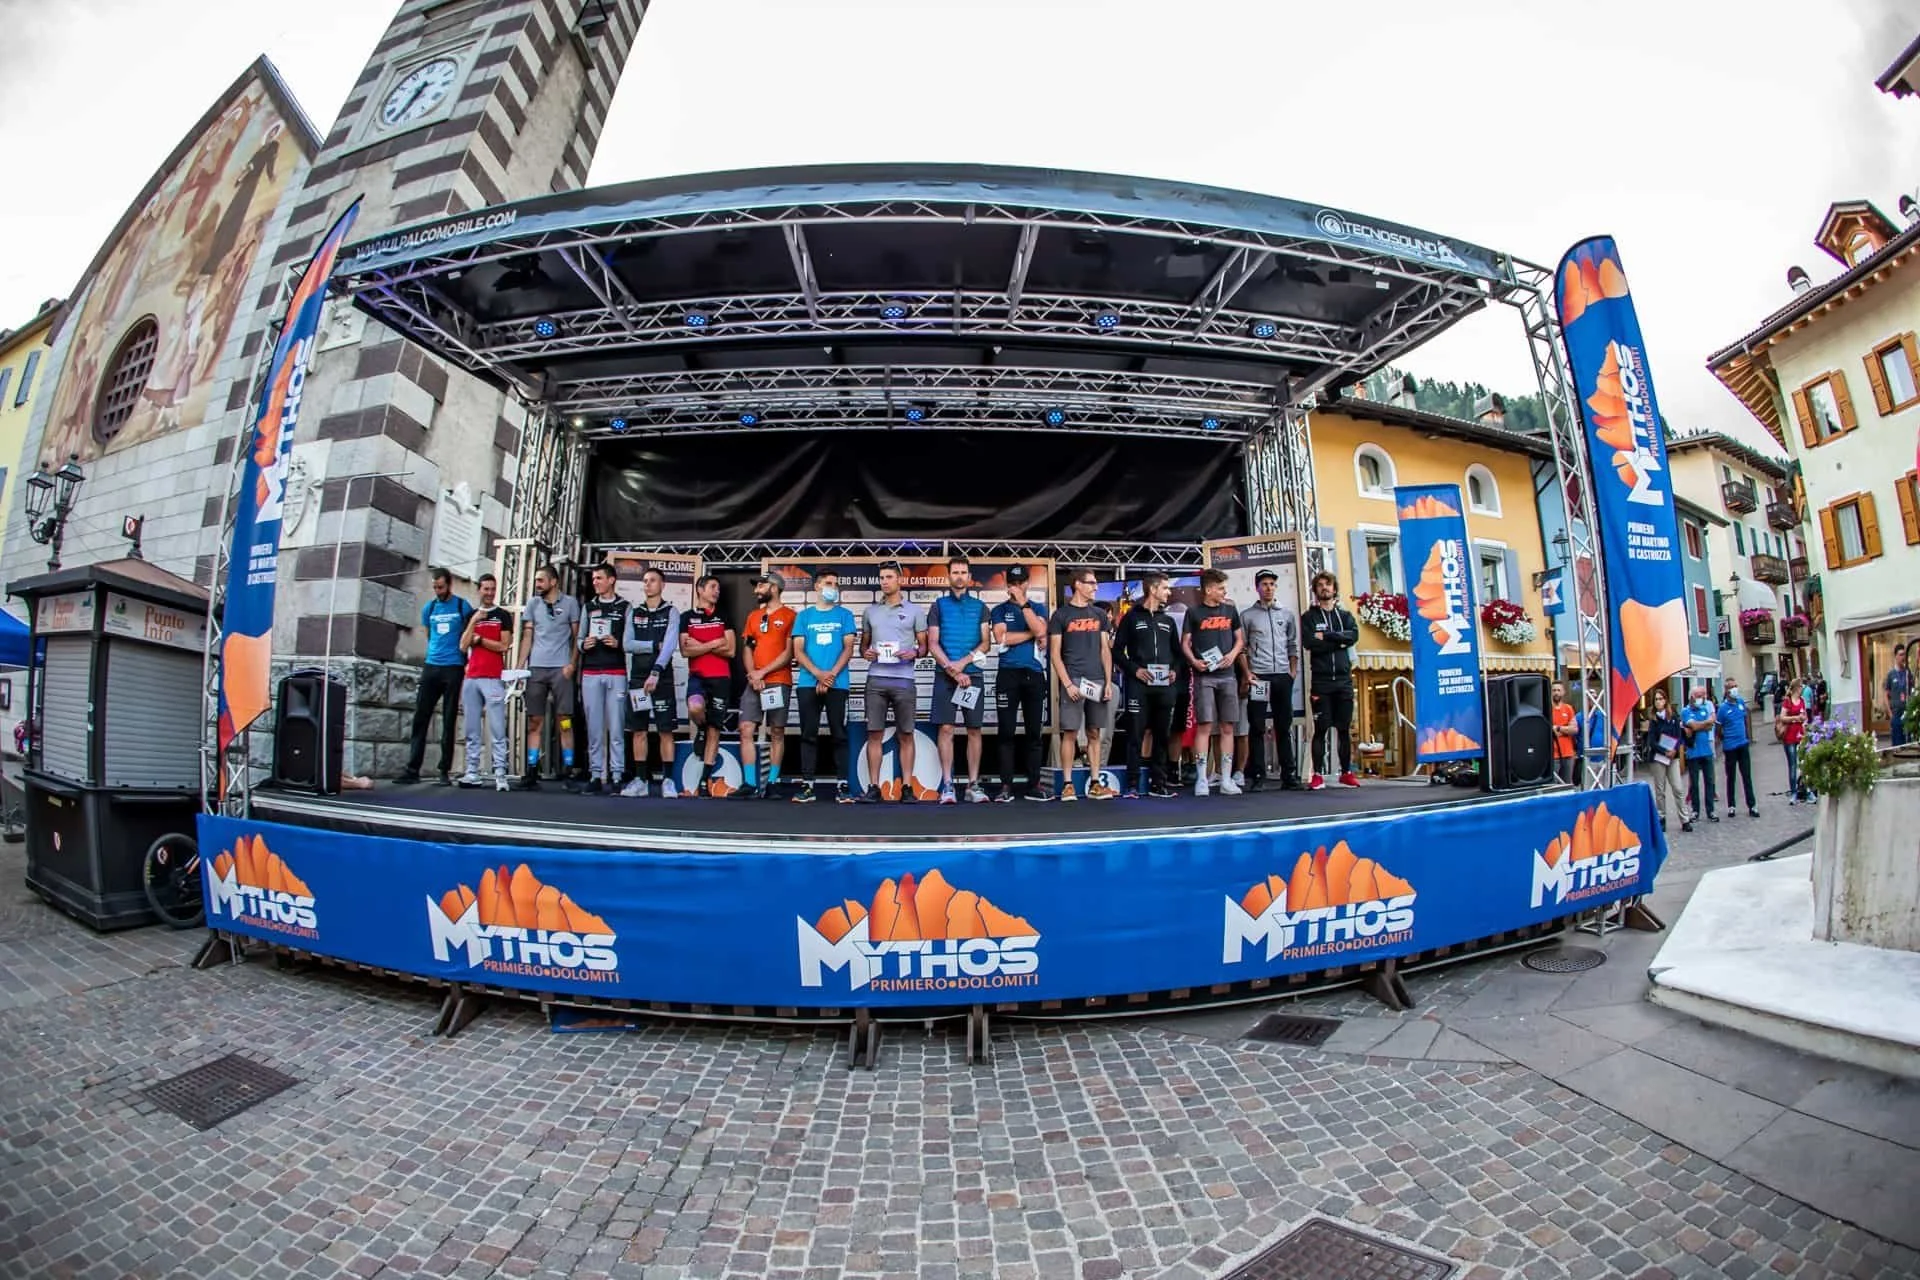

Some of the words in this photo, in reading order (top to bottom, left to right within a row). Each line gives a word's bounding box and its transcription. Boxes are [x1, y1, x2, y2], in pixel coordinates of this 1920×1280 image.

[1343, 220, 1437, 254] TECNOSOUND
[1247, 540, 1296, 554] WELCOME
[1628, 534, 1641, 546] SAN
[649, 561, 696, 572] WELCOME
[852, 576, 867, 585] SAN
[144, 605, 186, 630] Punto
[1067, 618, 1100, 632] KTM
[1200, 616, 1232, 631] KTM
[143, 624, 173, 642] Info
[885, 649, 892, 659] 11
[961, 691, 972, 702] 12
[1099, 772, 1109, 787] 3
[1530, 842, 1642, 908] MYTHOS
[206, 857, 318, 929] MYTHOS
[426, 894, 618, 971] MYTHOS
[1223, 888, 1417, 964] MYTHOS
[797, 914, 1041, 991] MYTHOS
